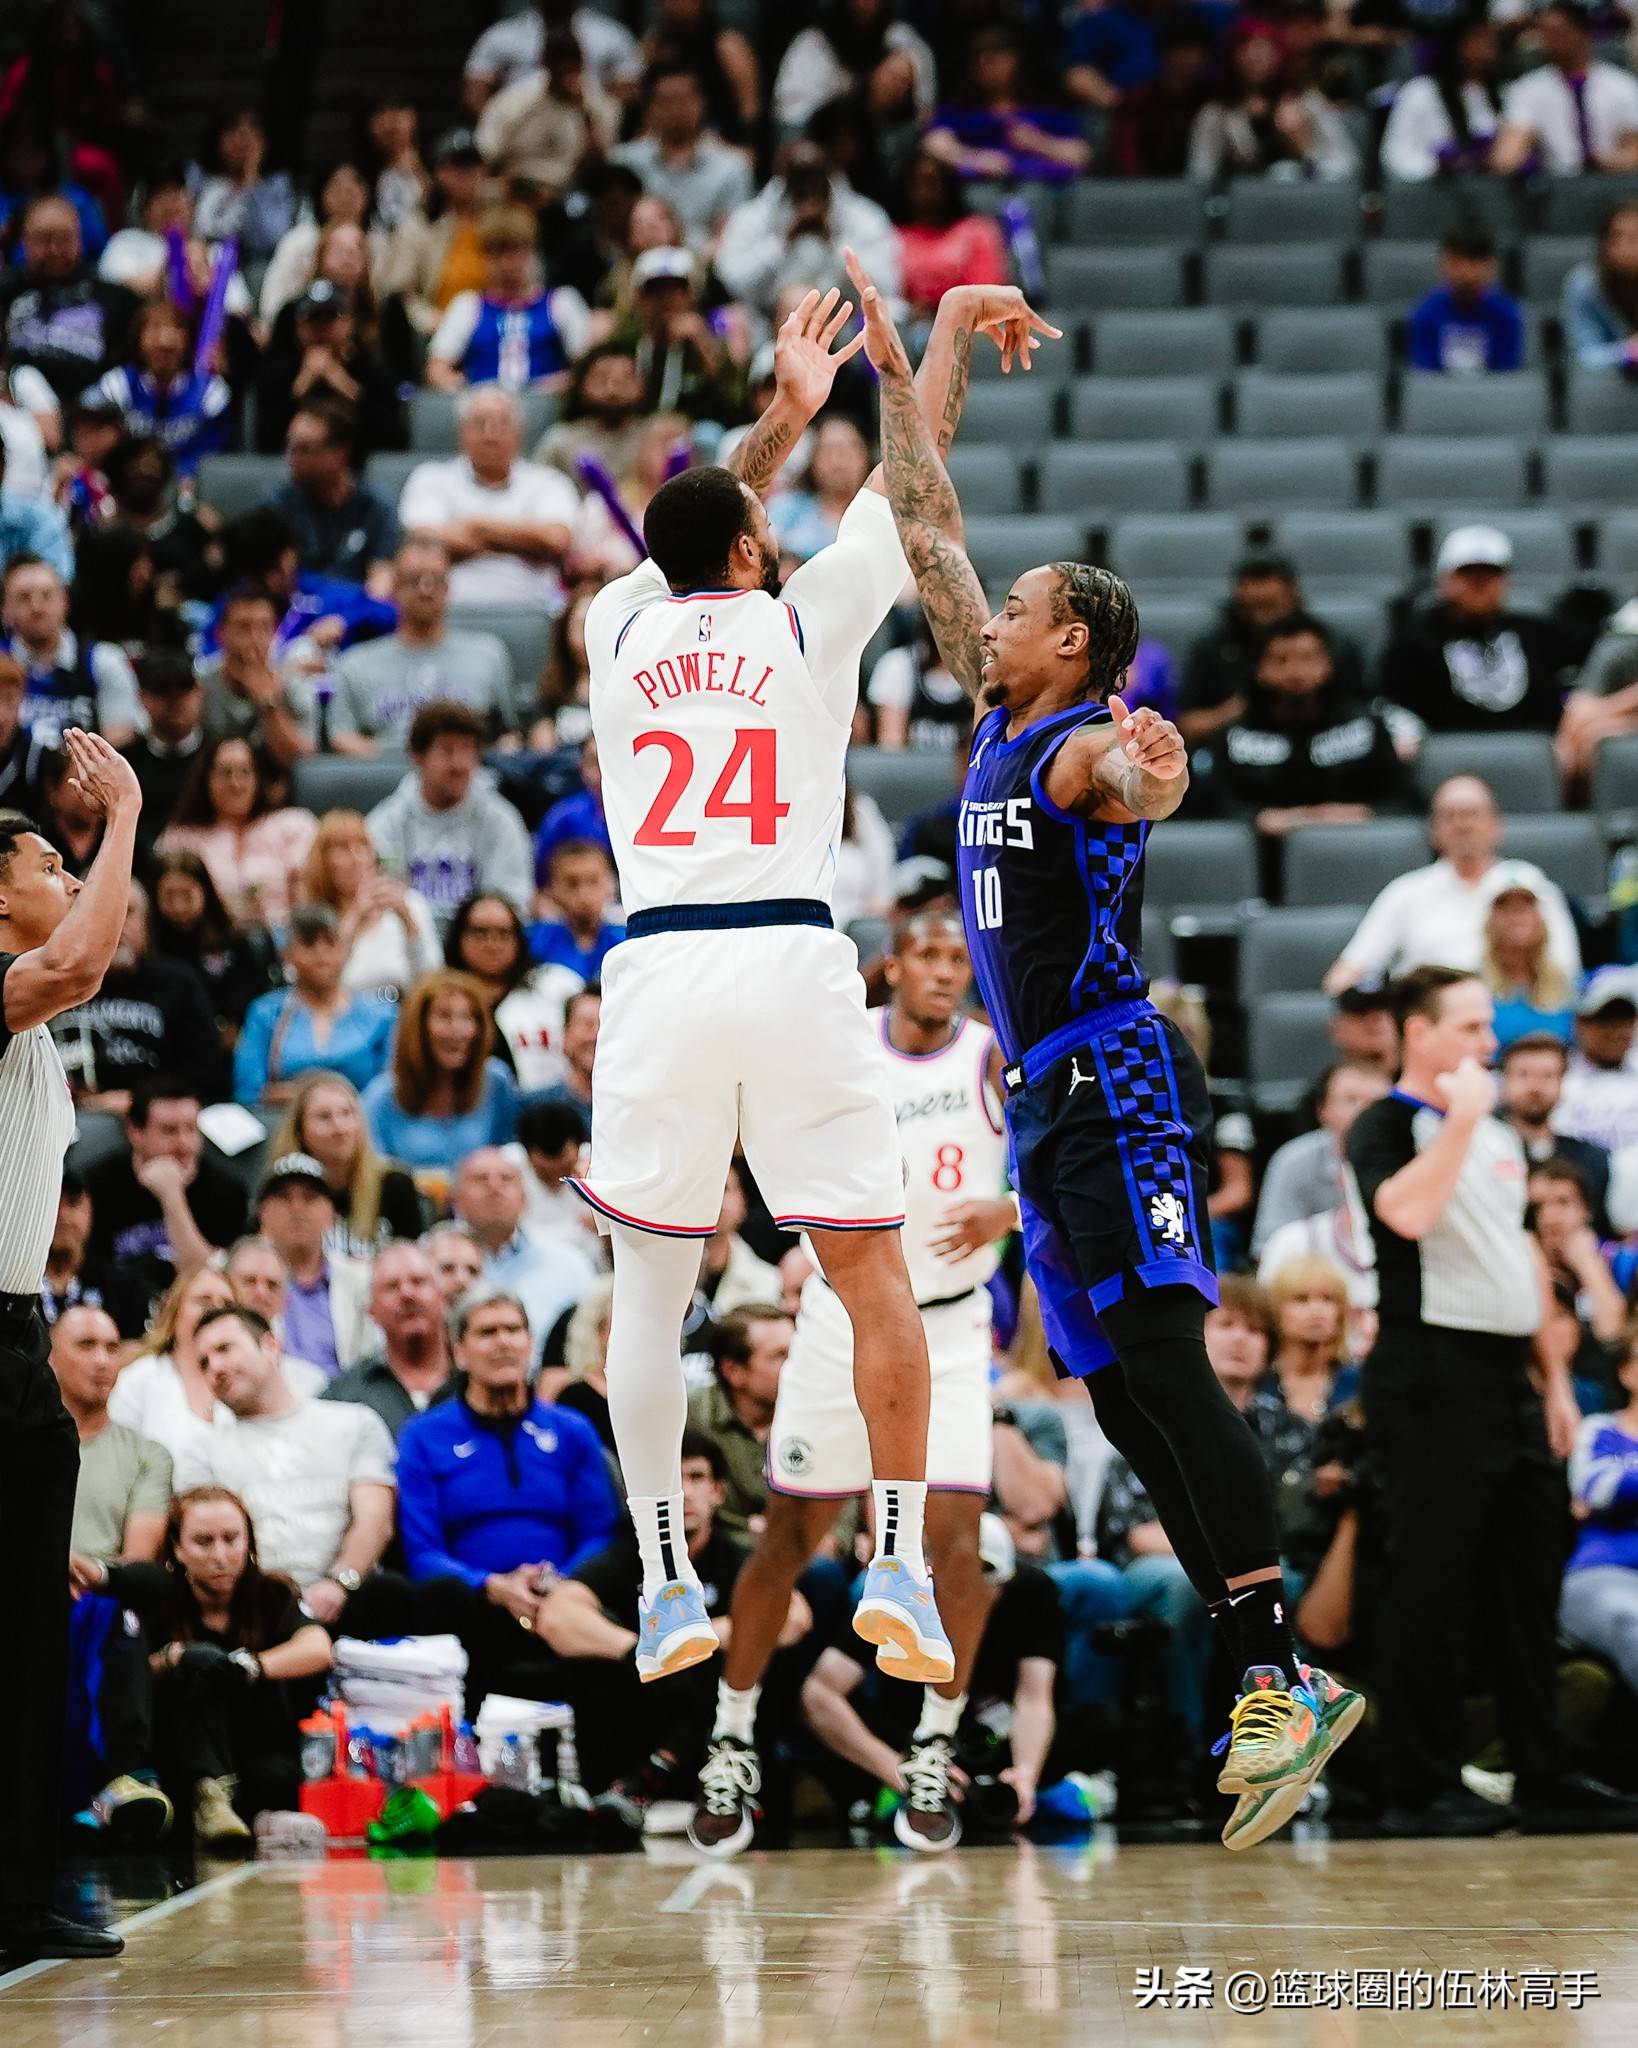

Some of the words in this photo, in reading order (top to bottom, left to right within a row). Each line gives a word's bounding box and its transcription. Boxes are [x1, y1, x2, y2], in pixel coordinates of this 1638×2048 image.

[633, 652, 774, 709] POWELL
[633, 729, 790, 846] 24
[972, 866, 1003, 931] 10
[932, 1142, 964, 1192] 8
